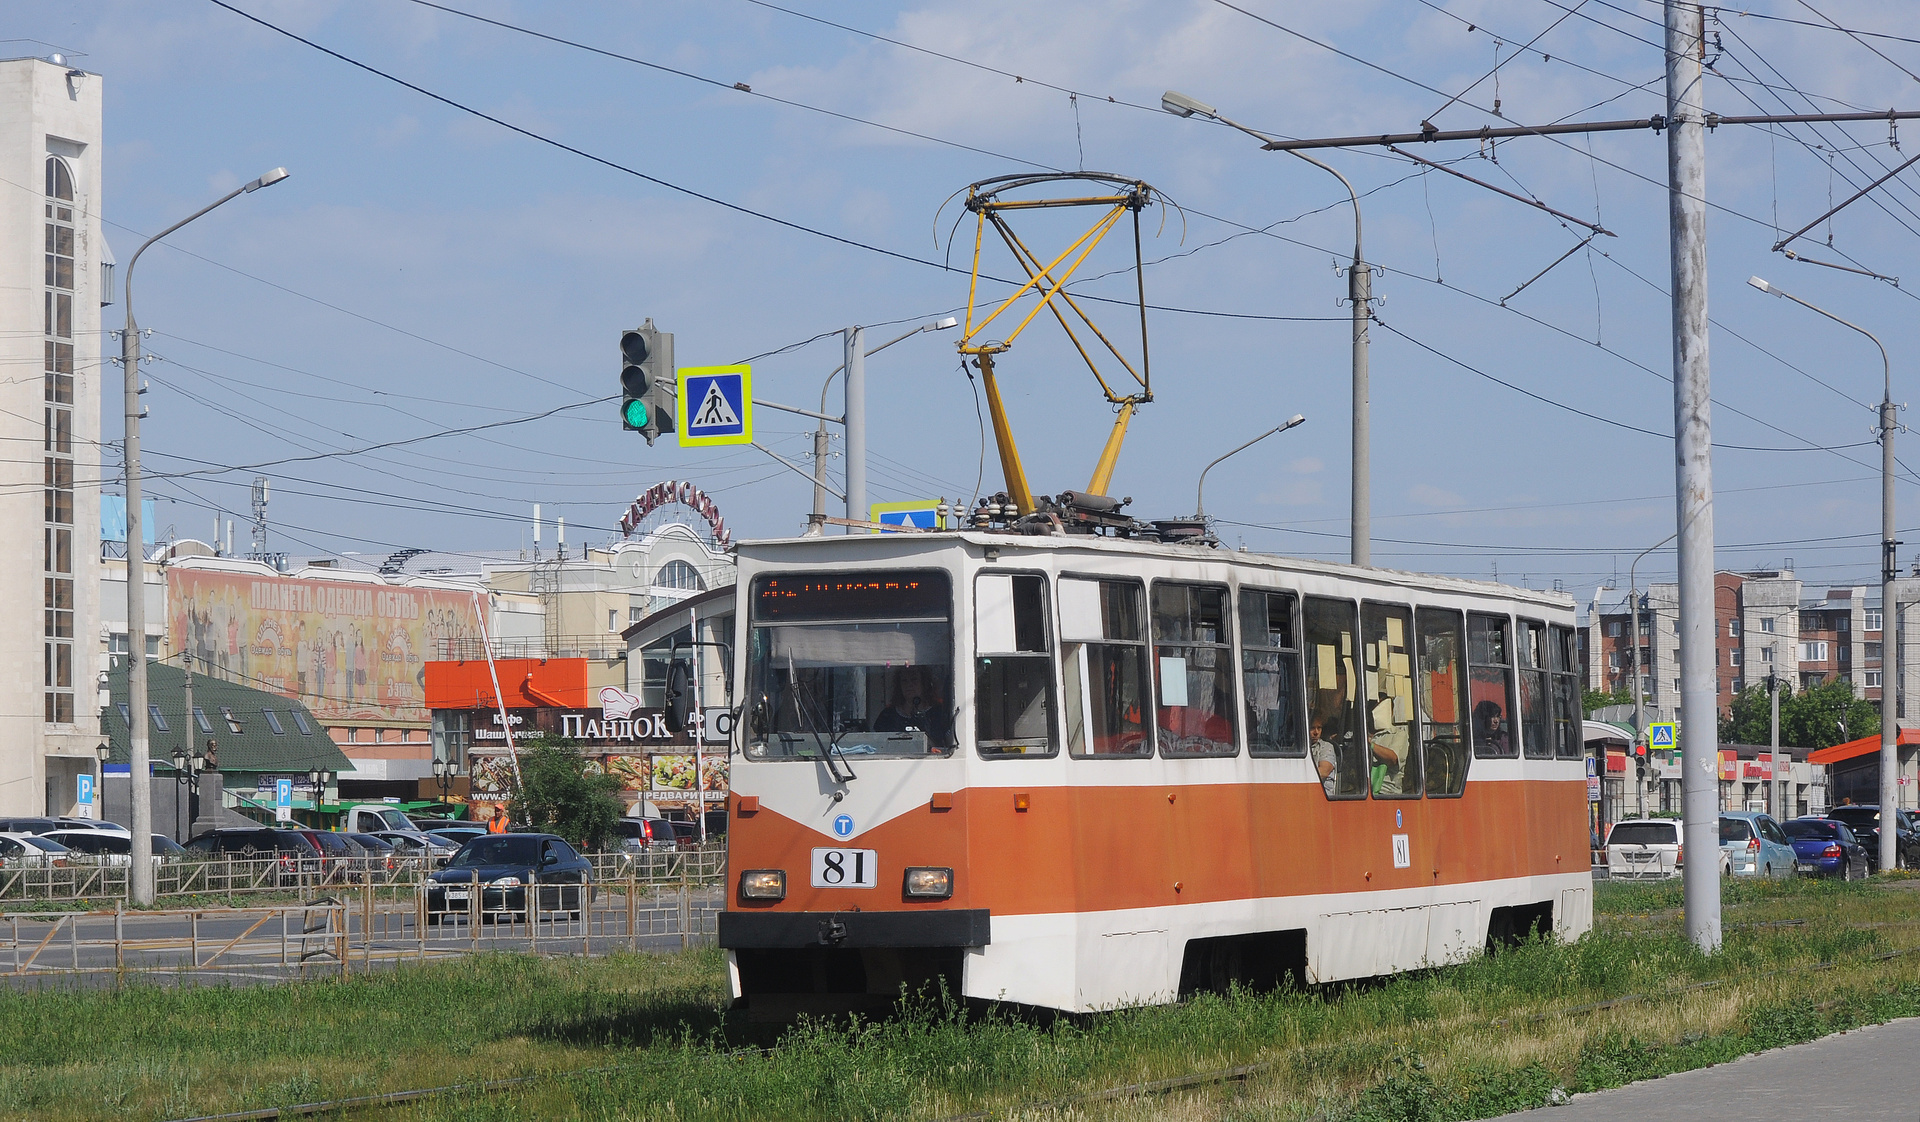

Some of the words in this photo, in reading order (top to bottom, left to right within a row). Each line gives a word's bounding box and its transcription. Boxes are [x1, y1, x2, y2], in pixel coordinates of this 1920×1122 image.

[251, 581, 313, 612] ПЛАНЕТА
[316, 586, 374, 620] ОДЕЖДА
[377, 590, 419, 620] ОБУВЬ
[387, 677, 394, 698] 3
[81, 779, 90, 800] P
[280, 785, 289, 802] P
[1396, 839, 1406, 864] 81
[822, 851, 867, 884] 81
